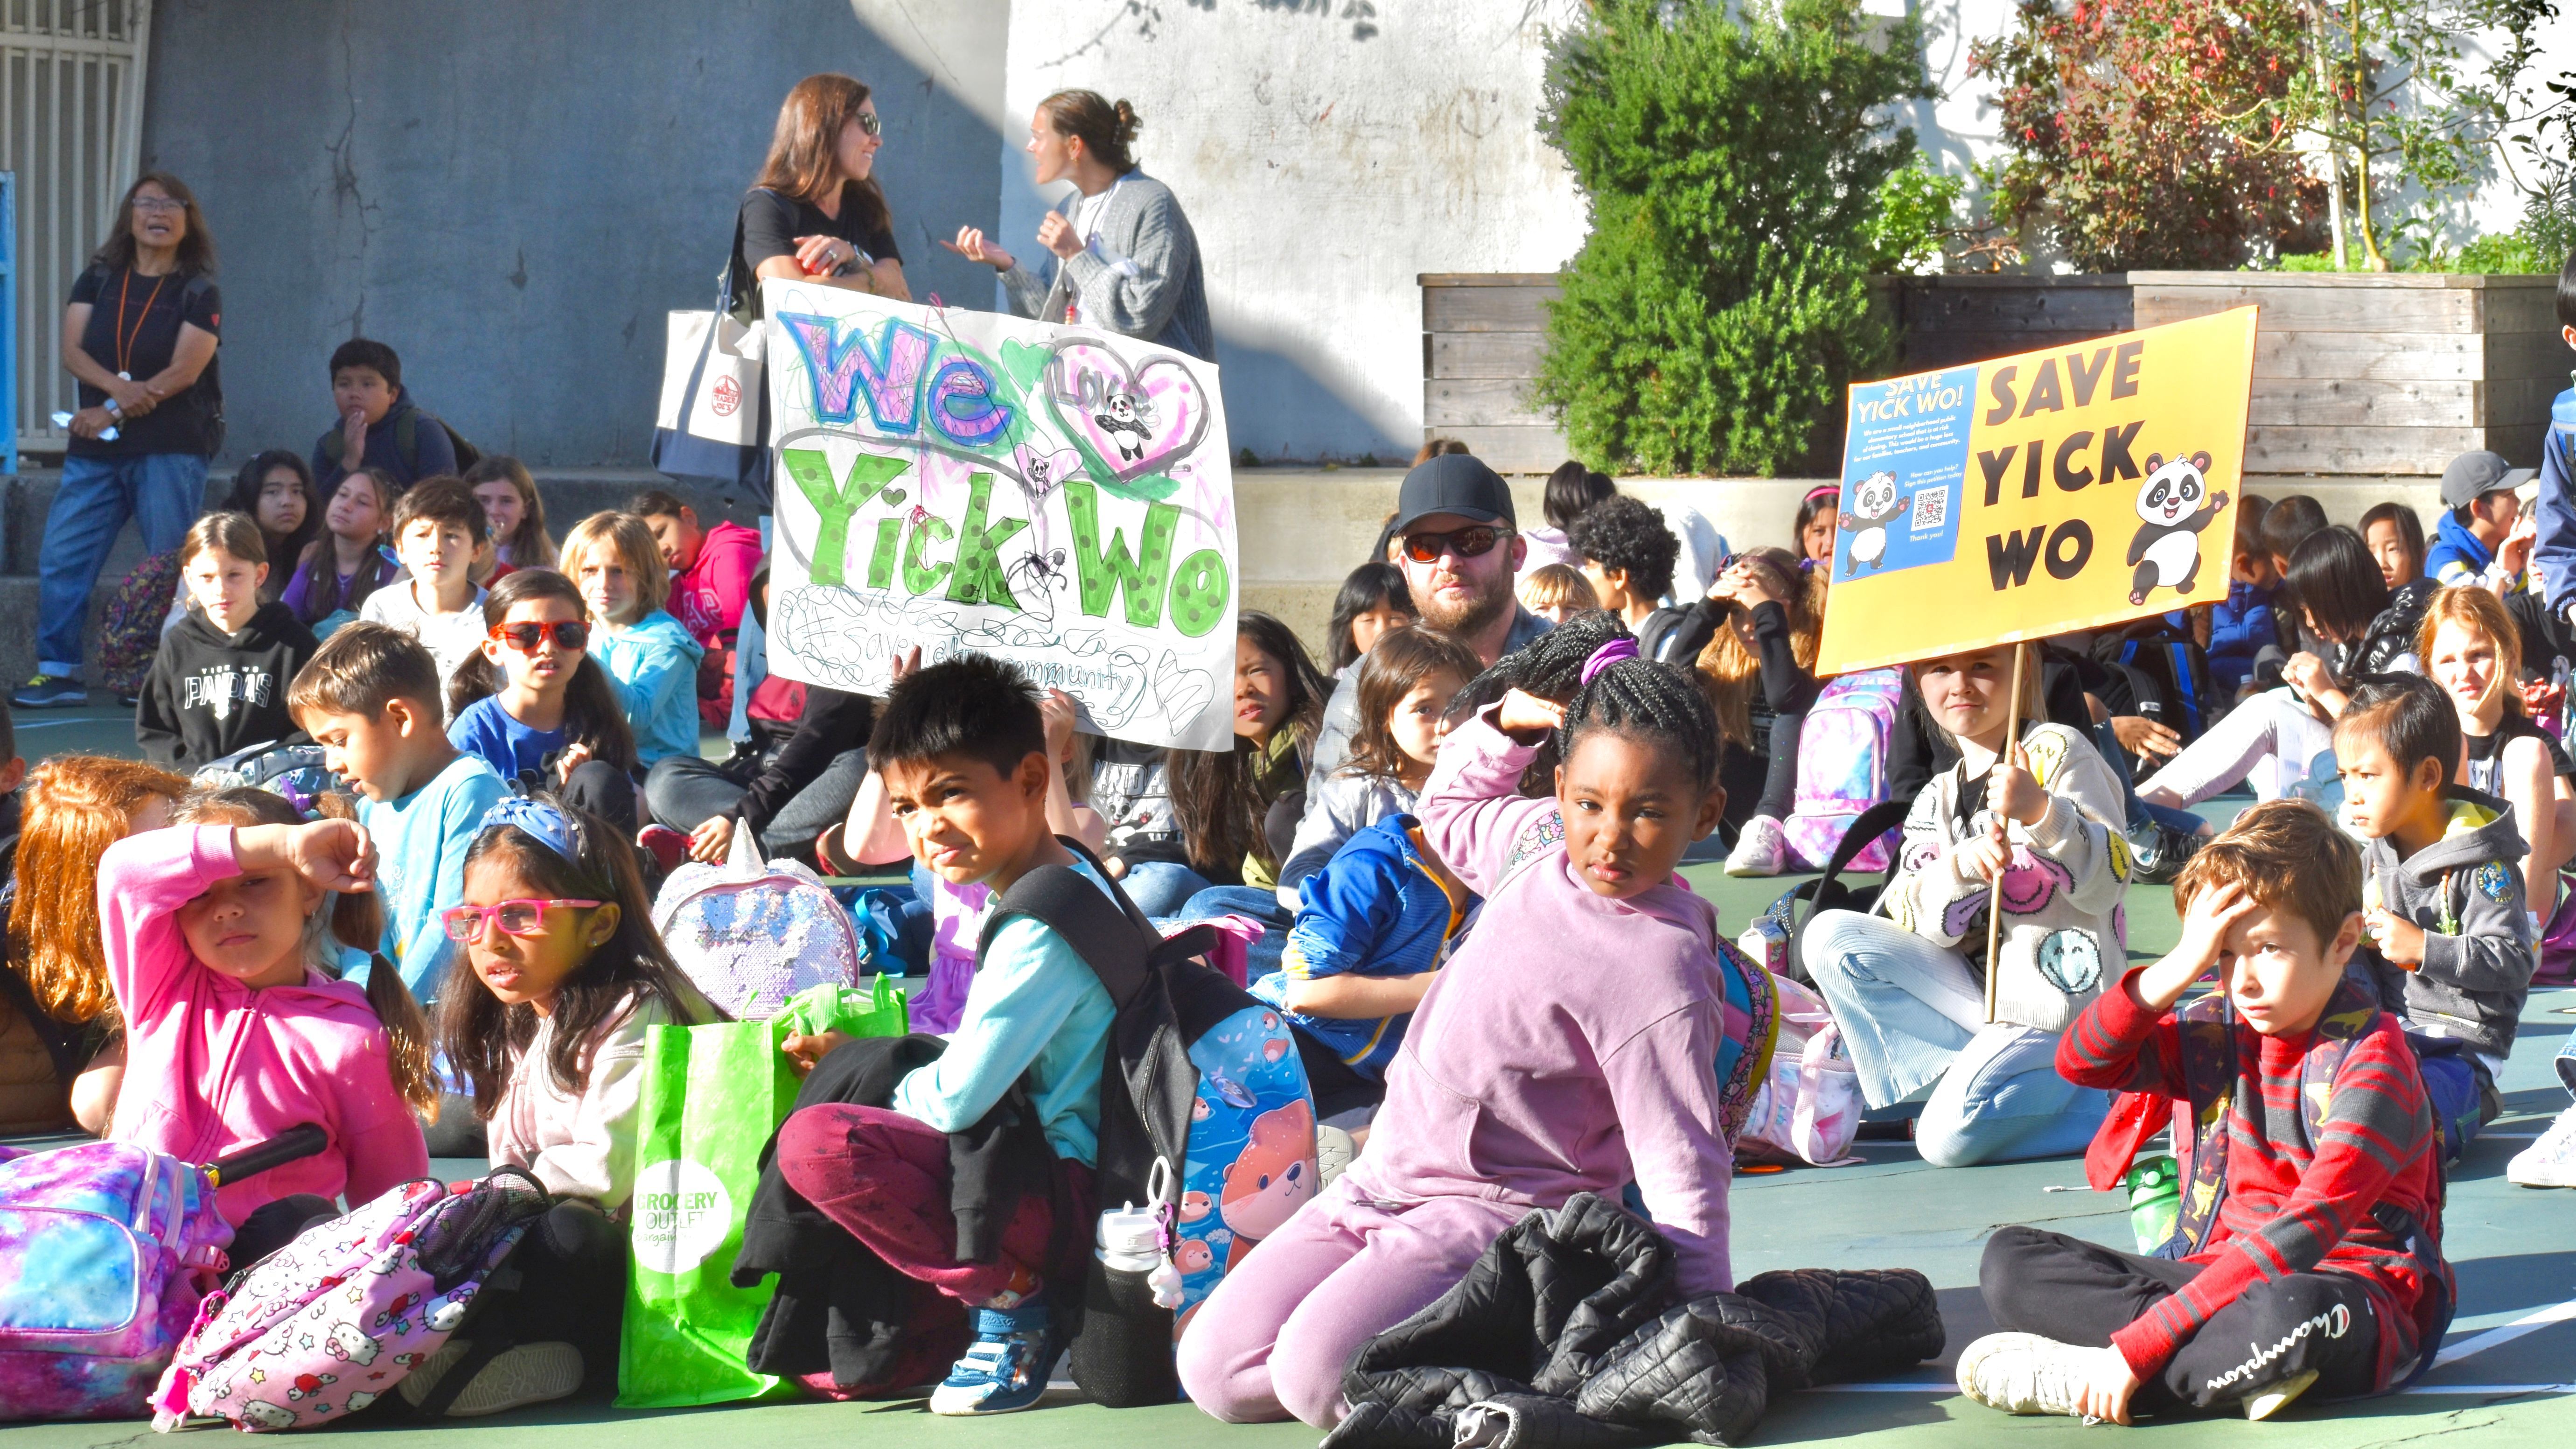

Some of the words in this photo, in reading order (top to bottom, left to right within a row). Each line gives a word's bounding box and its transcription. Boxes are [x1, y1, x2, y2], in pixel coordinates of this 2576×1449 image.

[776, 311, 1012, 447] We
[1884, 374, 1942, 397] SAVE
[1985, 339, 2144, 426] SAVE
[714, 394, 736, 404] TRADER
[1857, 395, 1912, 424] YICK
[1916, 384, 1964, 414] WO!
[1903, 417, 1940, 430] neighborhood
[1940, 415, 1956, 424] public
[1868, 434, 1898, 443] elementary
[1872, 450, 1893, 459] families,
[1894, 446, 1918, 455] teachers,
[1930, 438, 1961, 448] community.
[1976, 420, 2145, 507] YICK
[1927, 475, 1947, 484] petition
[782, 448, 1029, 608] Yick
[1062, 480, 1229, 637] Wo
[1910, 533, 1929, 542] Thank
[1929, 530, 1944, 540] you!
[1986, 518, 2094, 591] WO
[184, 672, 273, 709] PANDAS
[637, 1192, 718, 1210] GROCERY
[646, 1211, 706, 1229] OUTLET
[2207, 1303, 2350, 1389] Champion
